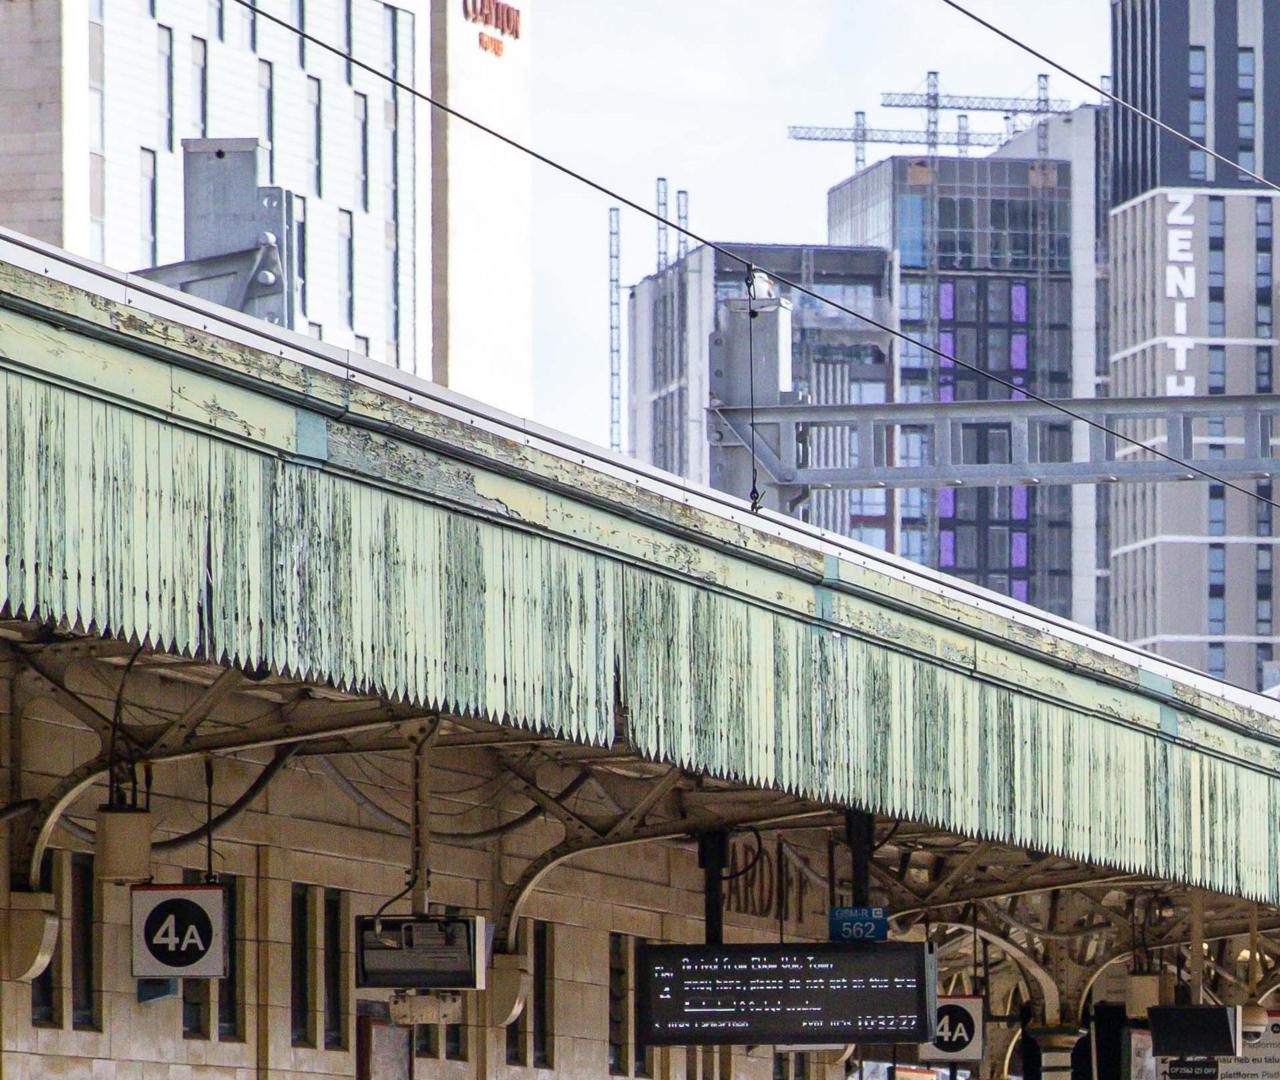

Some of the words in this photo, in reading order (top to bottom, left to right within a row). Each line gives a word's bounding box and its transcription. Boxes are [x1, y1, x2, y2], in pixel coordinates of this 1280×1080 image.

[1165, 193, 1196, 397] ZENITH
[152, 913, 205, 952] 4A
[842, 922, 876, 940] 562
[936, 1014, 970, 1042] 4A
